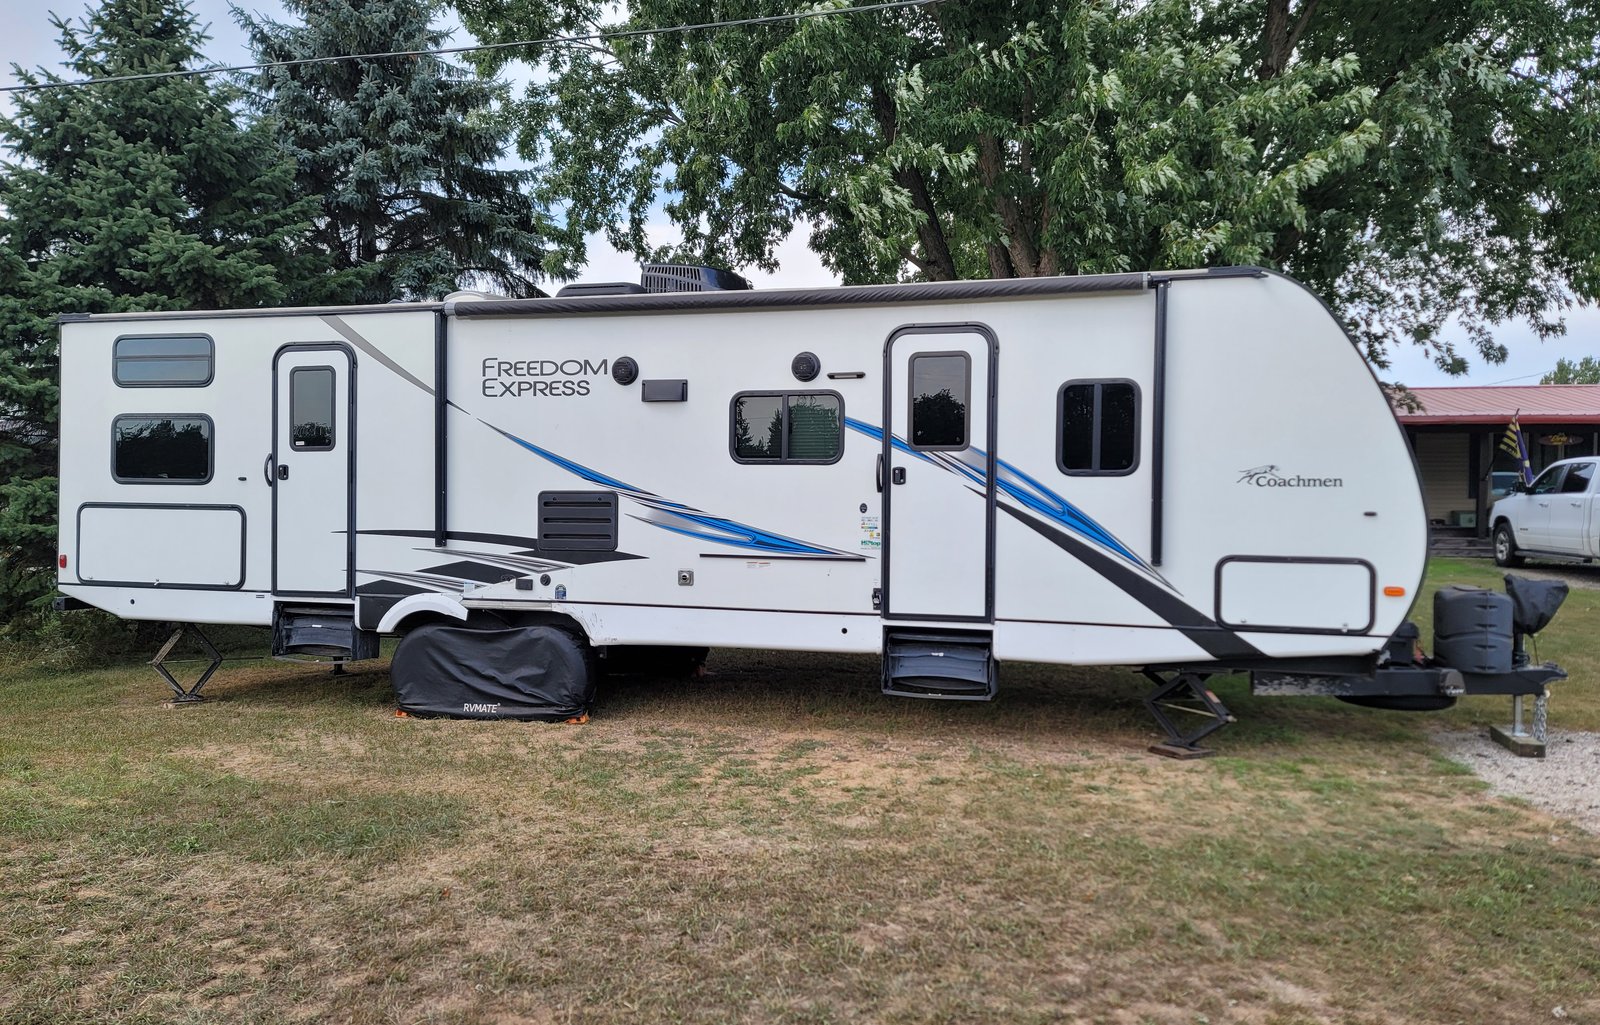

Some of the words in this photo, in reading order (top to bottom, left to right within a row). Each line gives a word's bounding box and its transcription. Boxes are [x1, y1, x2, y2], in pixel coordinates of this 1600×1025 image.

[481, 357, 608, 377] FREEDOM
[481, 378, 591, 397] EXPRESS
[1256, 475, 1343, 487] Coachmen
[463, 703, 498, 713] RVMATE
